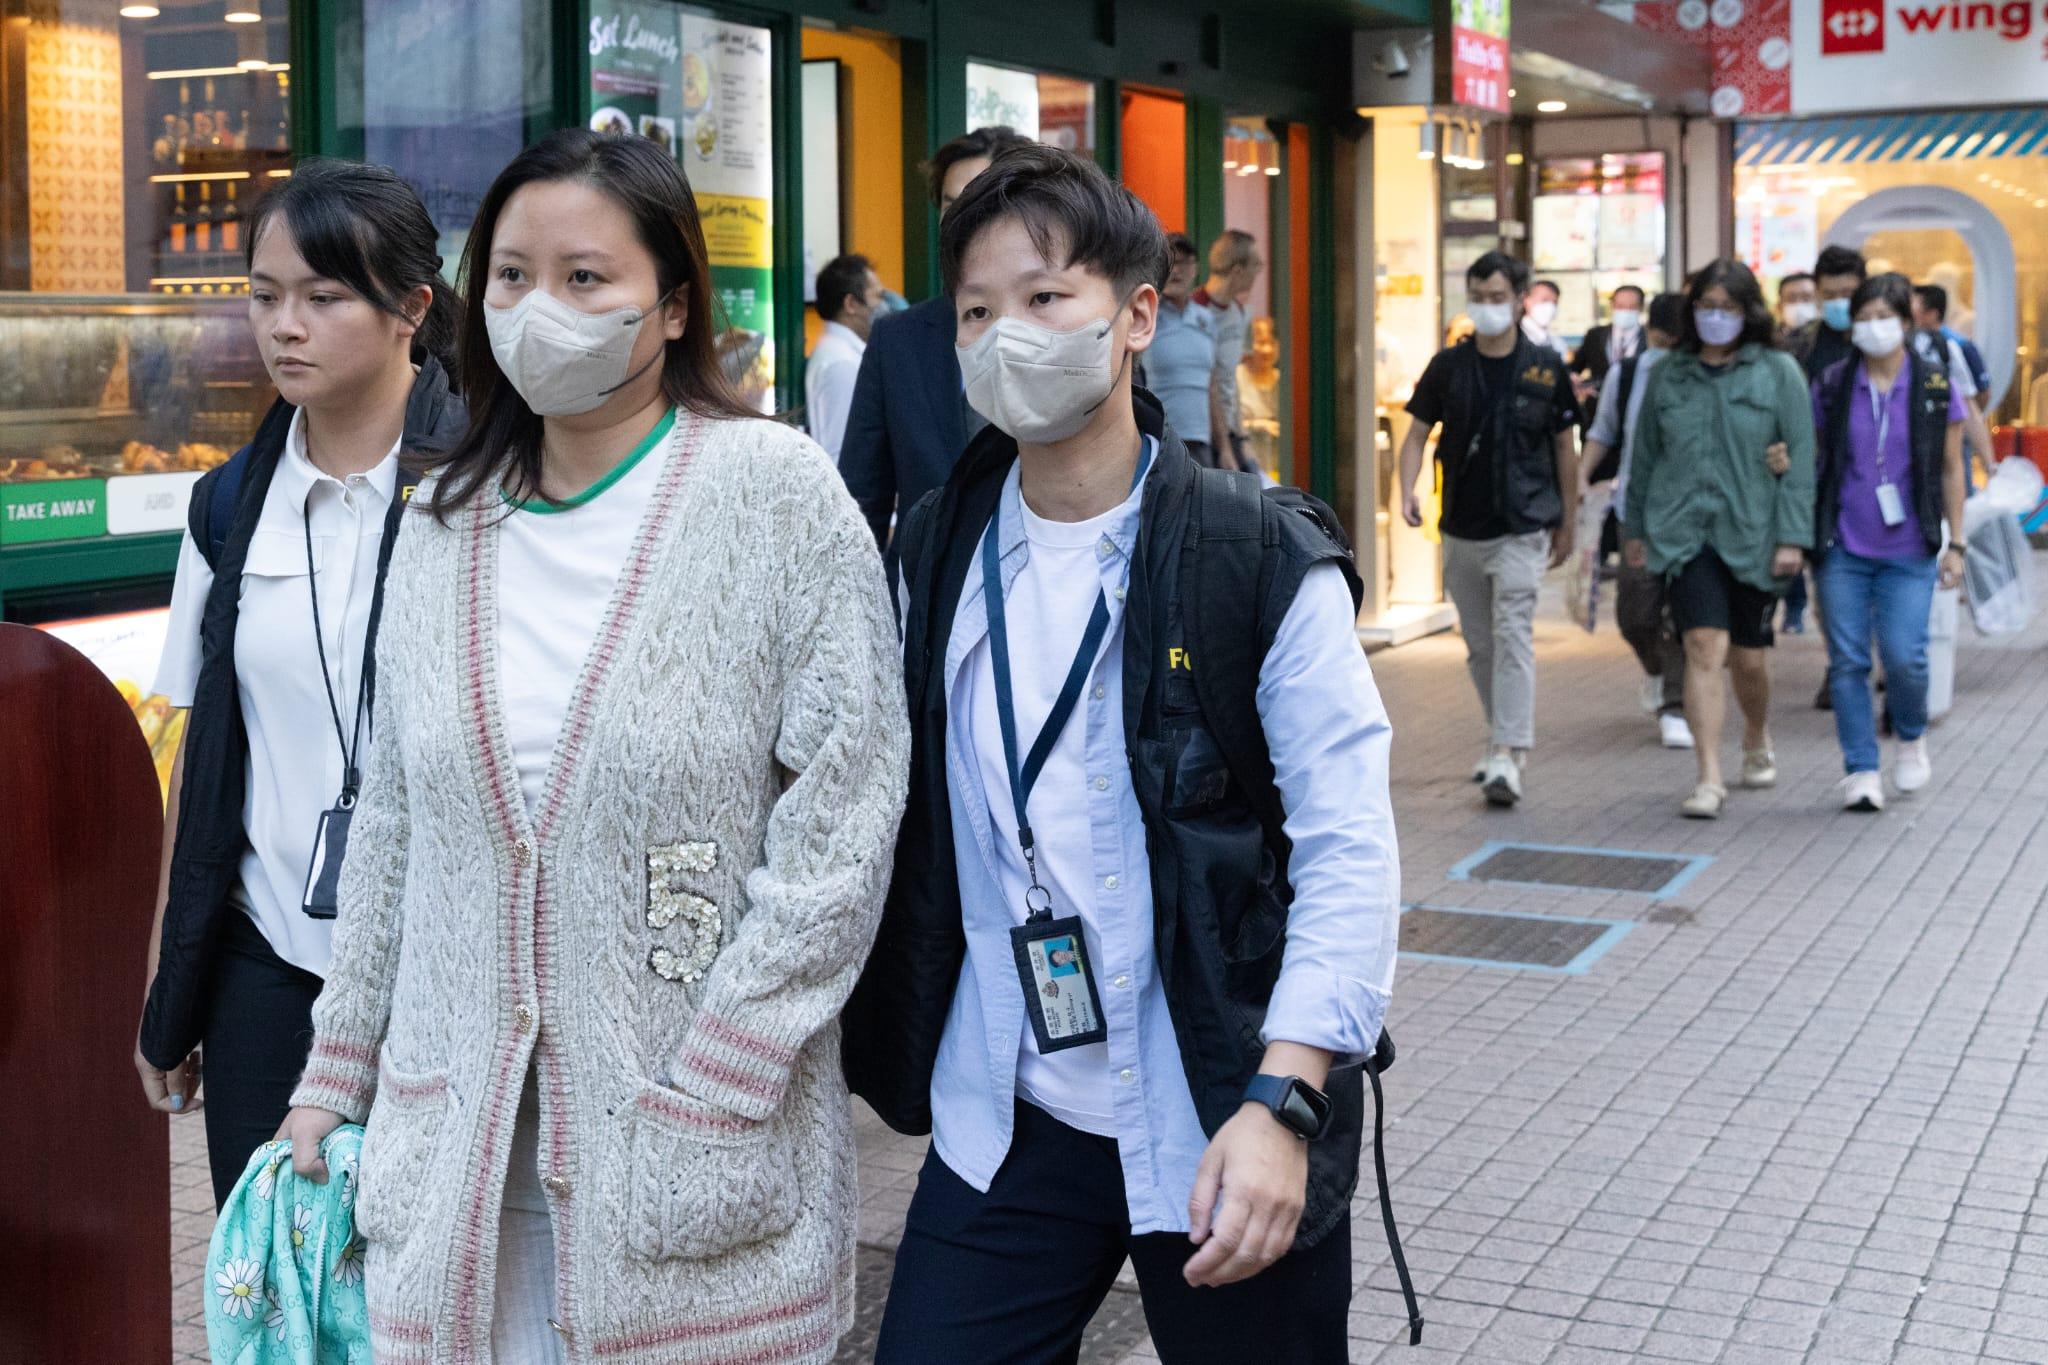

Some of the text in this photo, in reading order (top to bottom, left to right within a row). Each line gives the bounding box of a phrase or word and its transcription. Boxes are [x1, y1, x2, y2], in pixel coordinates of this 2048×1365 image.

[589, 14, 678, 63] Set Lunch
[1897, 1, 2032, 41] wing
[6, 498, 96, 521] TAKE AWAY
[647, 841, 721, 983] 5
